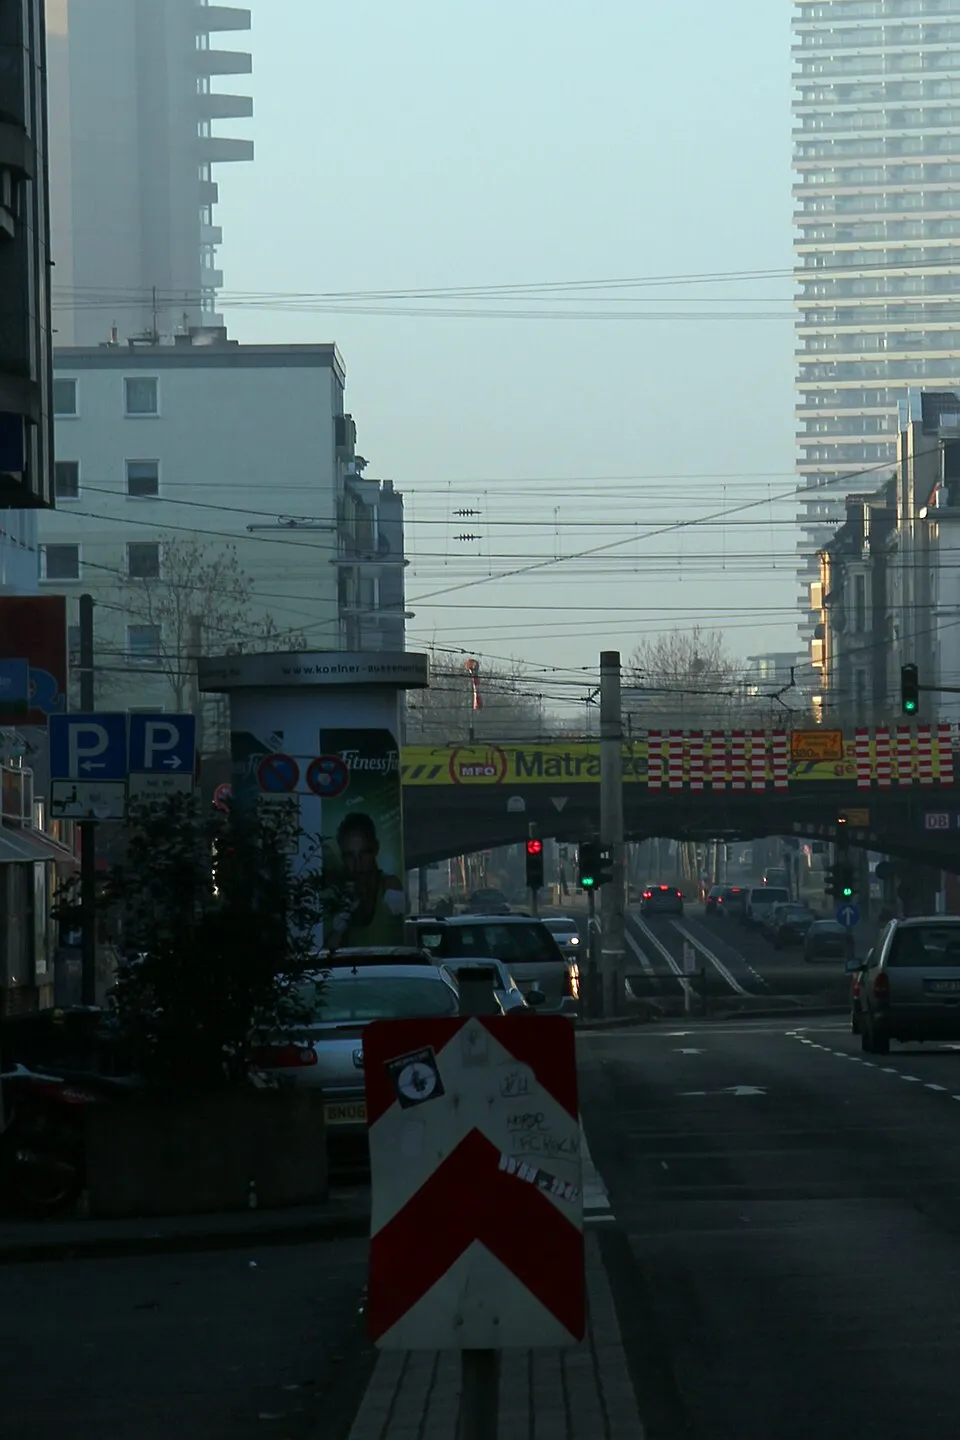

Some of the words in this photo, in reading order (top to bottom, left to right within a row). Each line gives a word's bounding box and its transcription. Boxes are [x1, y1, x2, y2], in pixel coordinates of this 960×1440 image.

[68, 723, 109, 777] P
[144, 721, 180, 768] P
[461, 765, 497, 777] MFO
[514, 751, 668, 778] Matraze
[927, 814, 948, 828] DB
